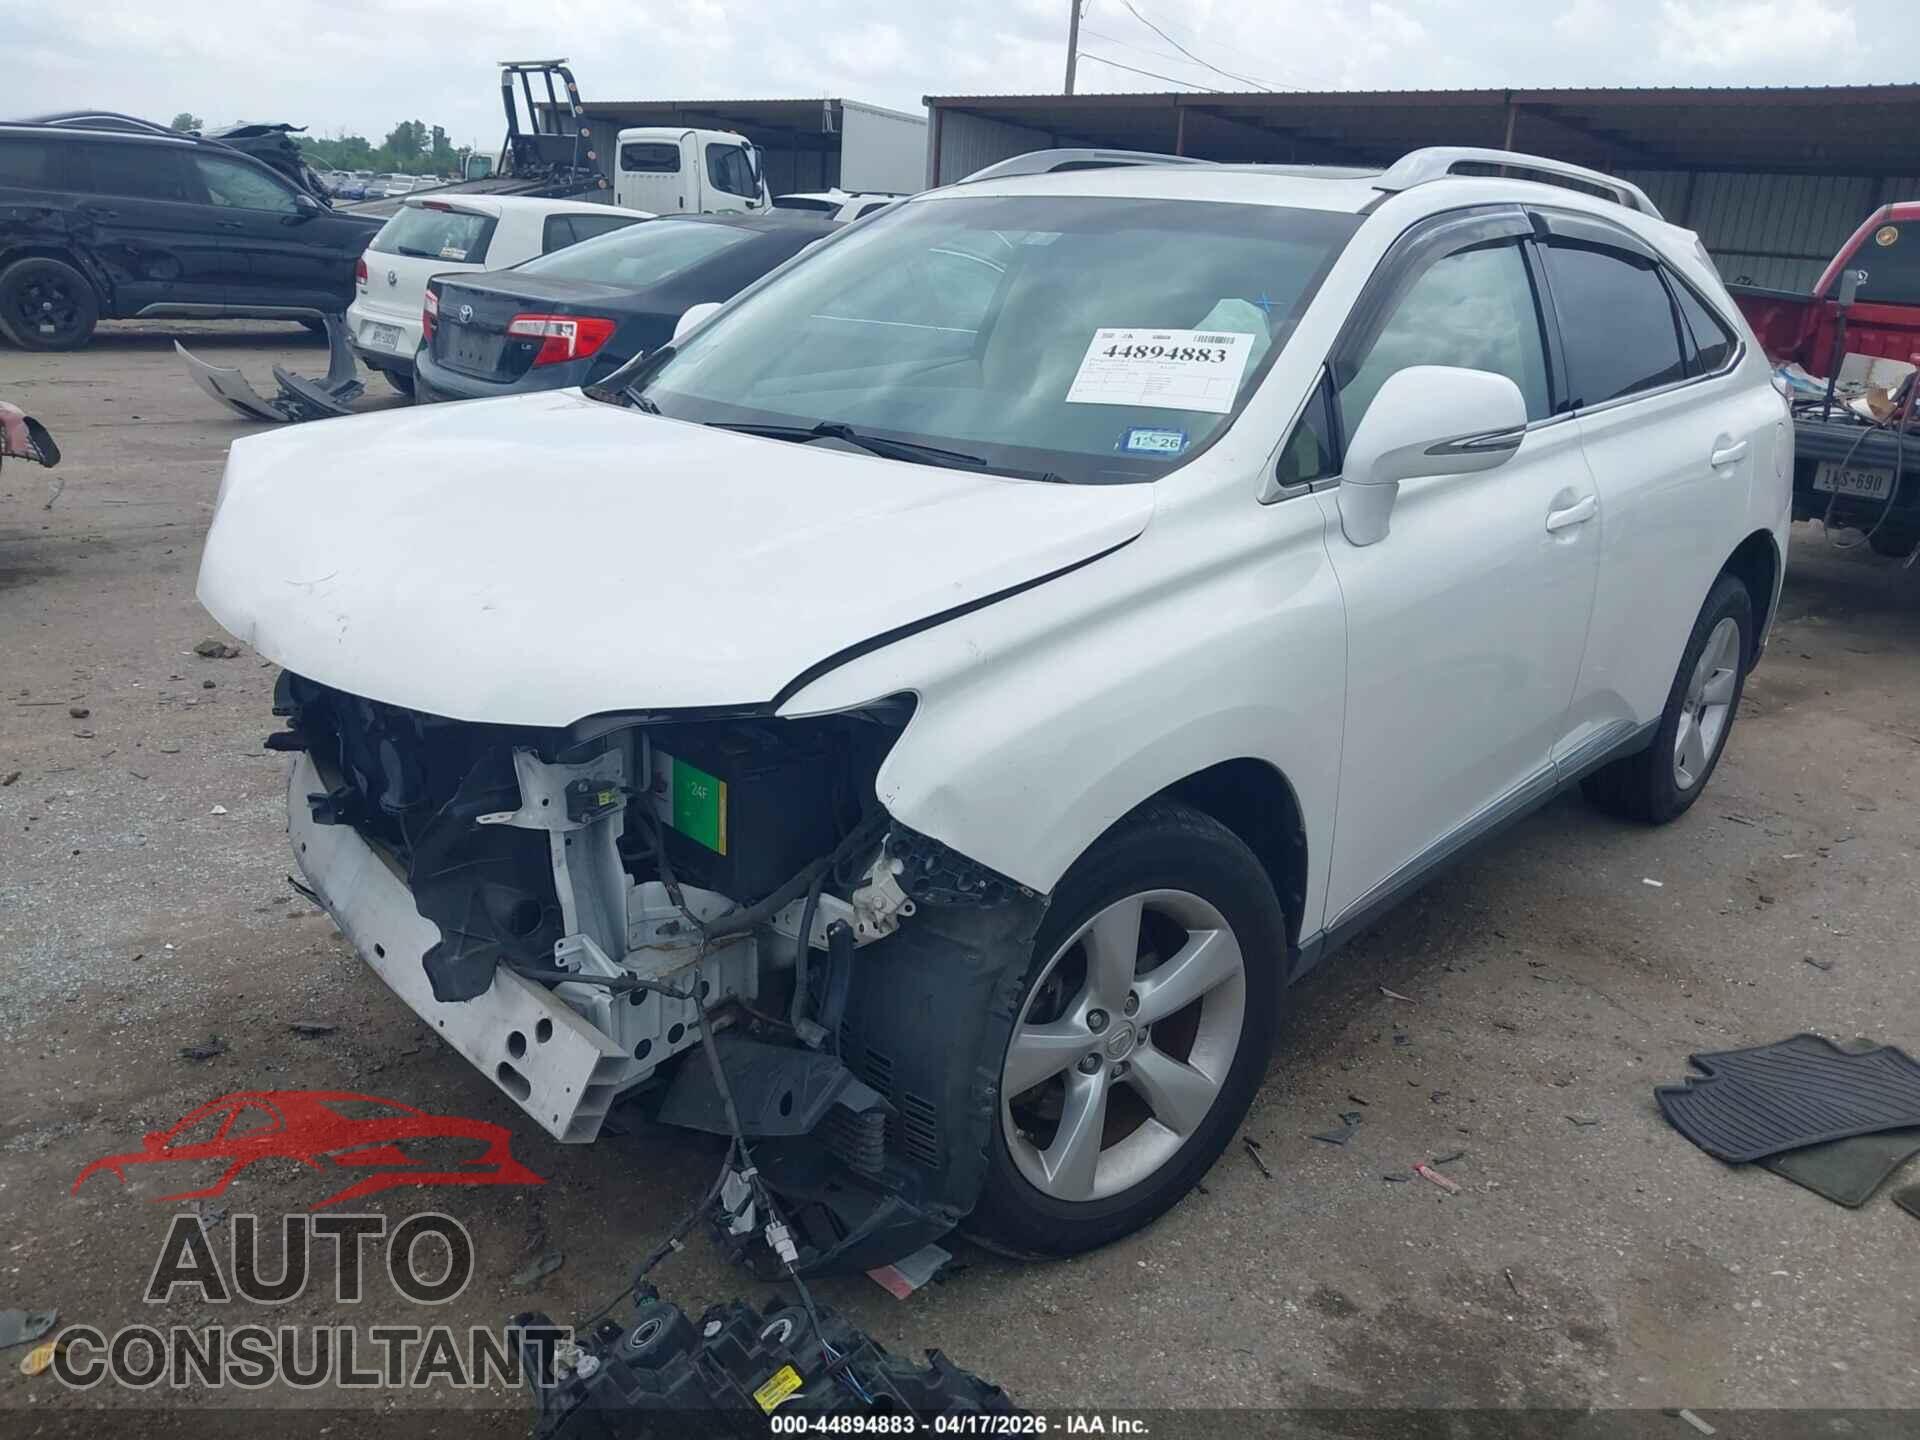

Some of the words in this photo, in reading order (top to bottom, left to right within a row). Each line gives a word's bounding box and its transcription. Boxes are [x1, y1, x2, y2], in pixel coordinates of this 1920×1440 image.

[1103, 344, 1226, 363] 44894883
[1159, 438, 1179, 449] 26
[690, 782, 708, 800] 24F
